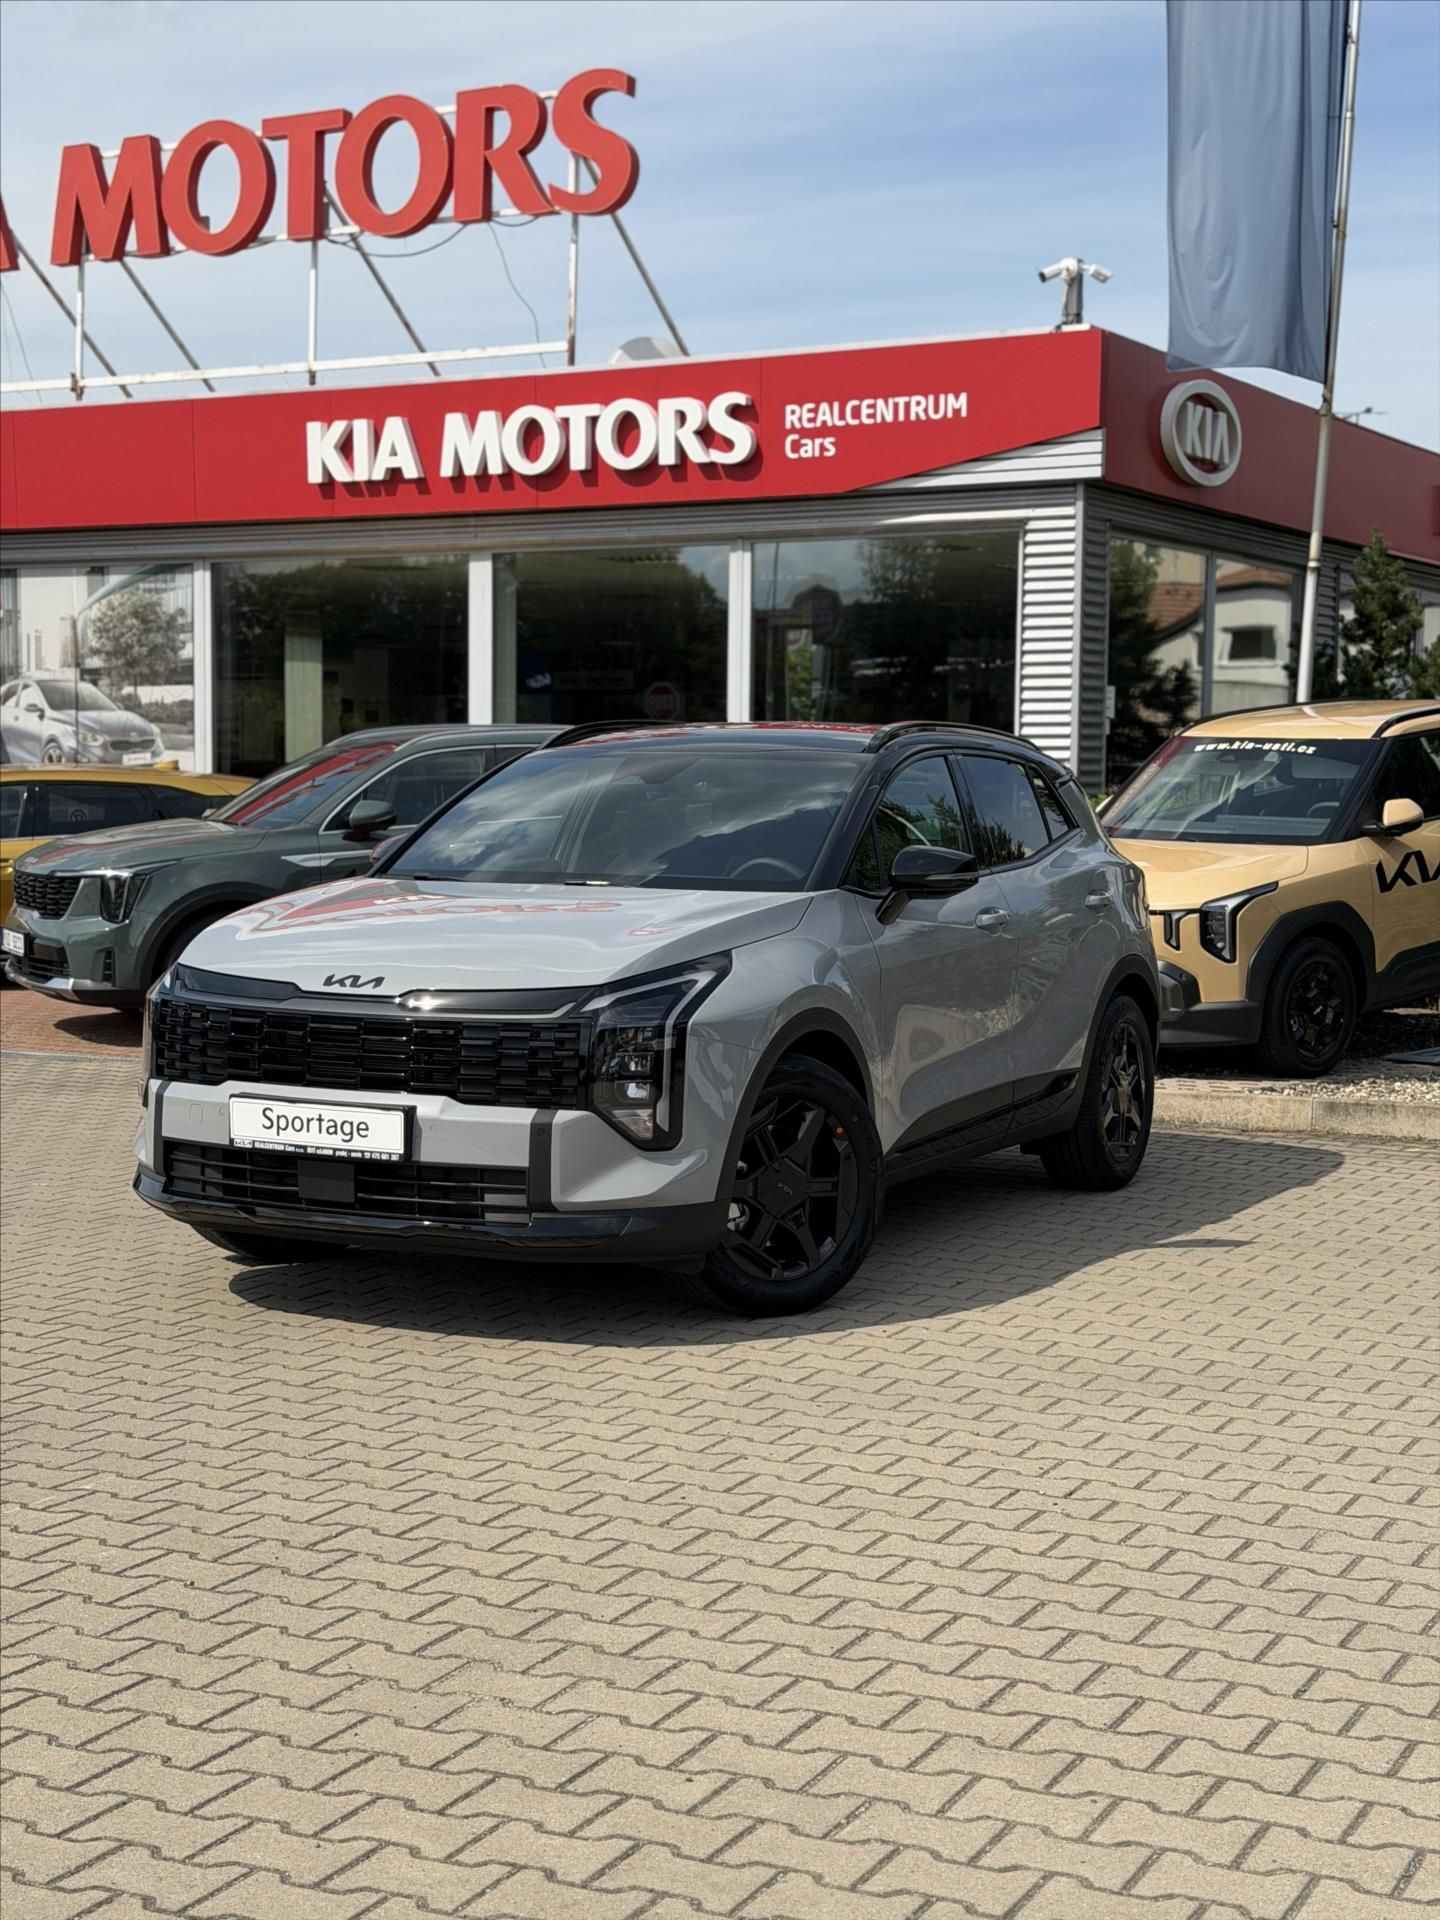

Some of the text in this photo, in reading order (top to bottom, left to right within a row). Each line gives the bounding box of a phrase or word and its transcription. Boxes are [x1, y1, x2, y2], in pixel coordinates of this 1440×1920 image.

[50, 68, 640, 268] MOTORS
[784, 392, 968, 430] REALCENTRUM
[305, 391, 757, 484] KIA MOTORS
[784, 433, 837, 459] Cars
[1186, 401, 1230, 464] KIA
[1193, 740, 1317, 755] www.kia-usti.cz
[261, 1107, 370, 1143] Sportage
